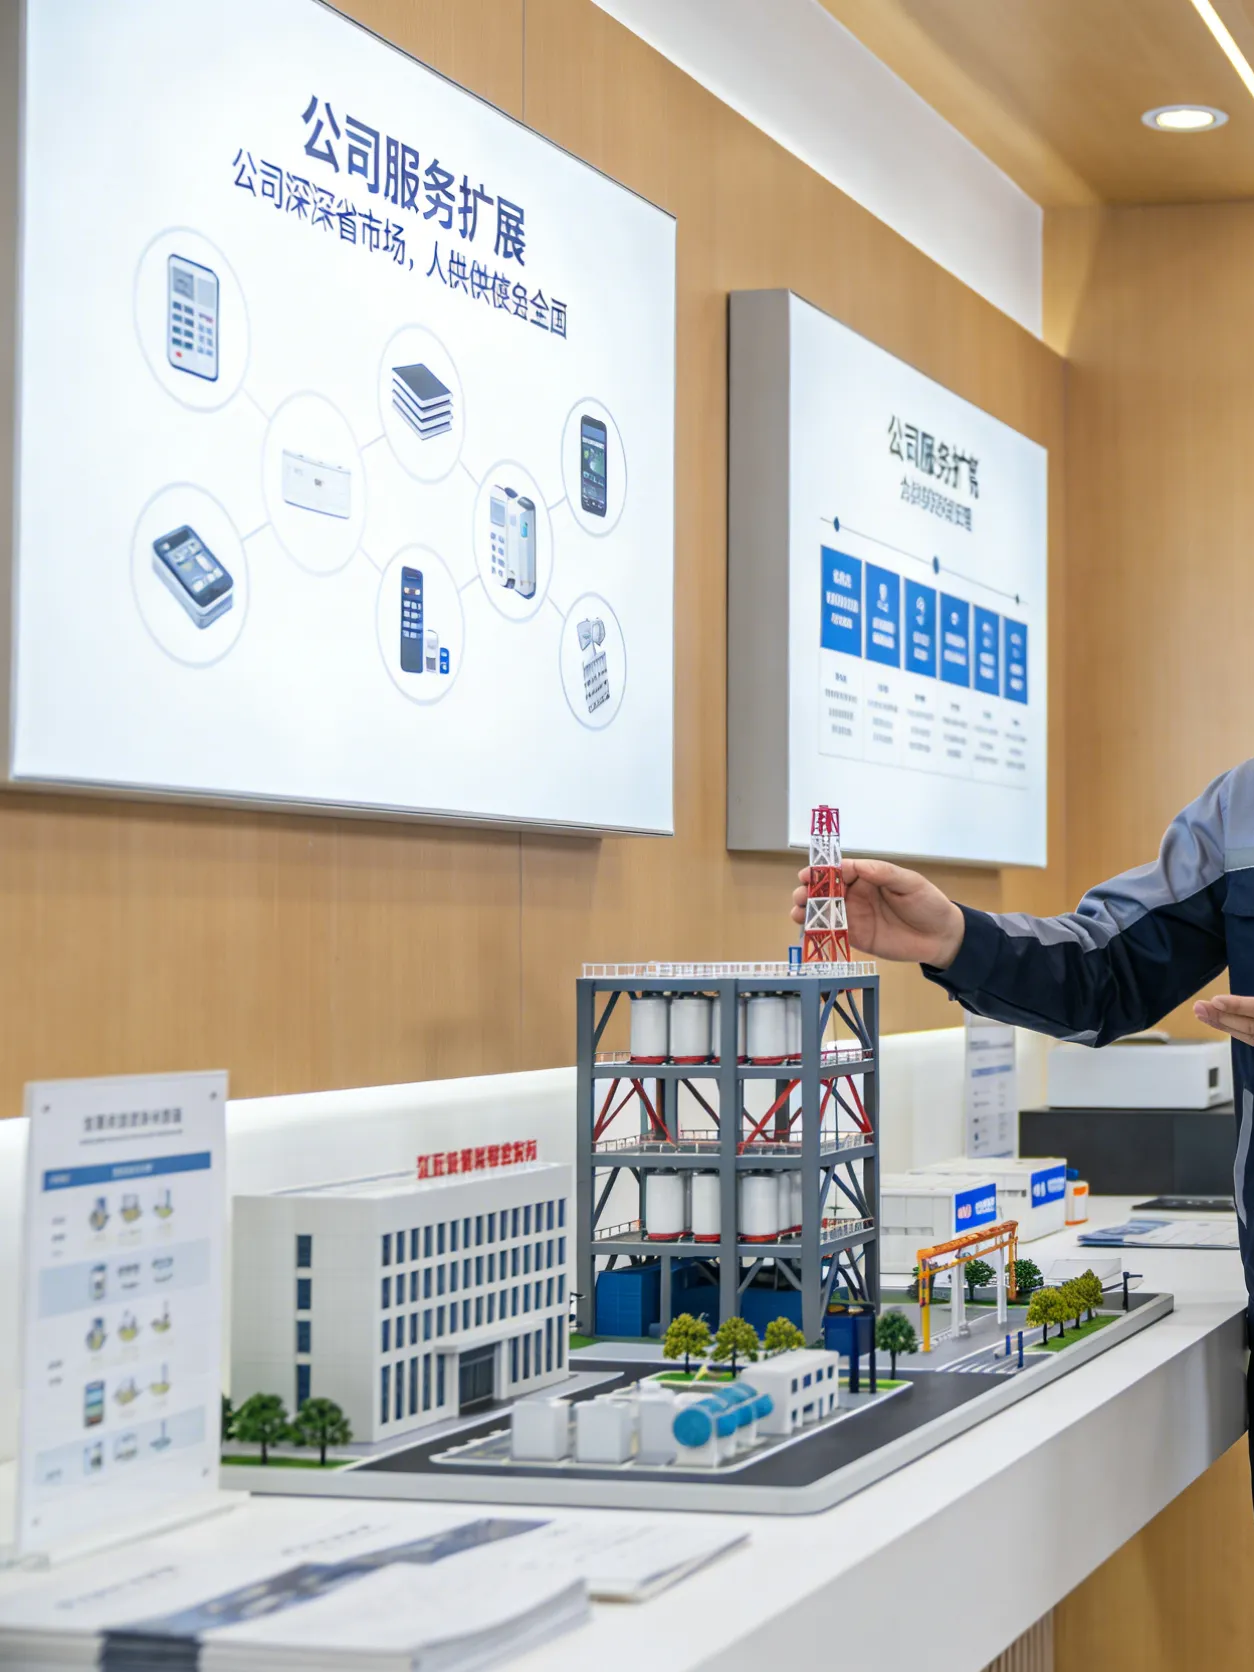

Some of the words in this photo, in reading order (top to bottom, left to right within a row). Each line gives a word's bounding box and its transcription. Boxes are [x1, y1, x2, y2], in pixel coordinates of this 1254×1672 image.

[301, 94, 527, 267] 公司服务扩展
